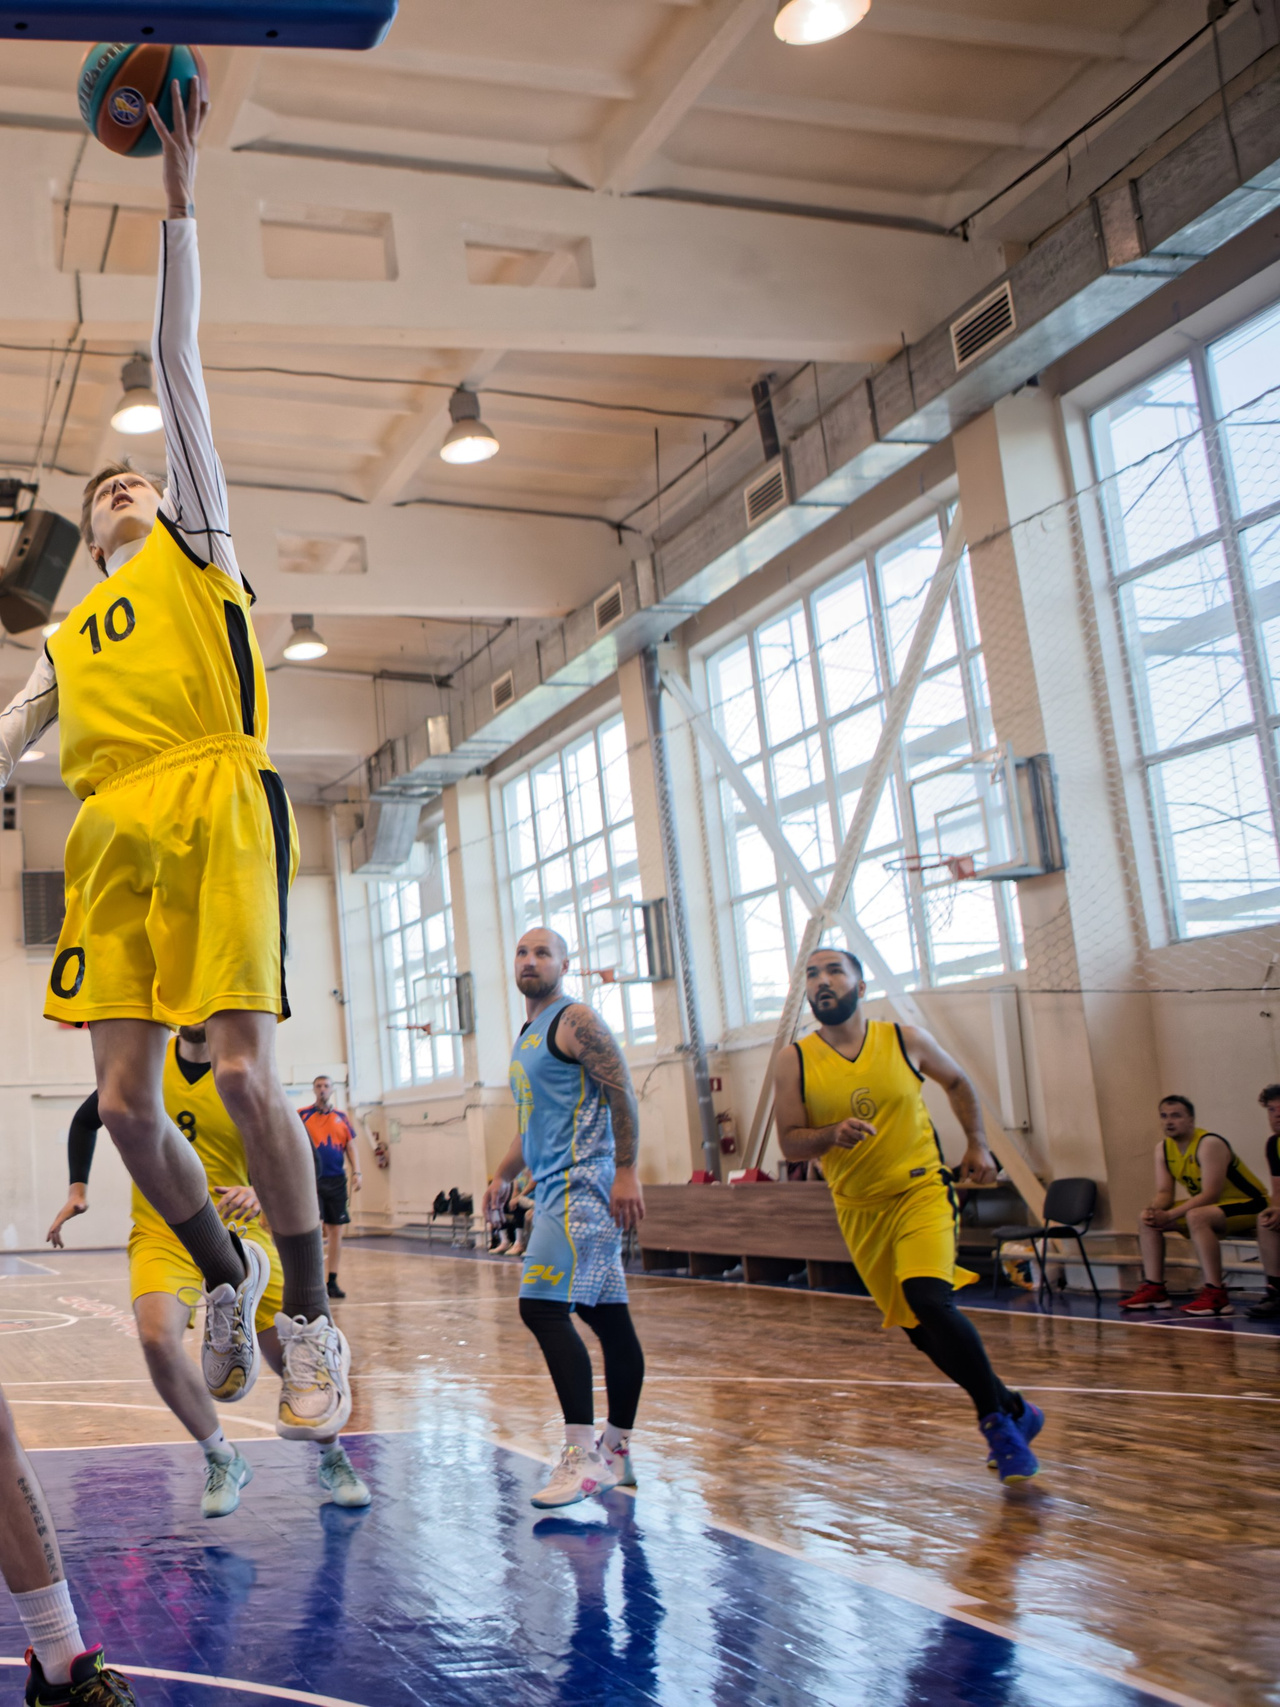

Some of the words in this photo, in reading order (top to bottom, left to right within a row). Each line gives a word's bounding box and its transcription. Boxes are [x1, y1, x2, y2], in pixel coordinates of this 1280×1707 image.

[79, 597, 136, 655] 10
[521, 1033, 543, 1050] 24
[850, 1087, 877, 1120] 6
[176, 1110, 196, 1142] 8
[523, 1264, 565, 1286] 24
